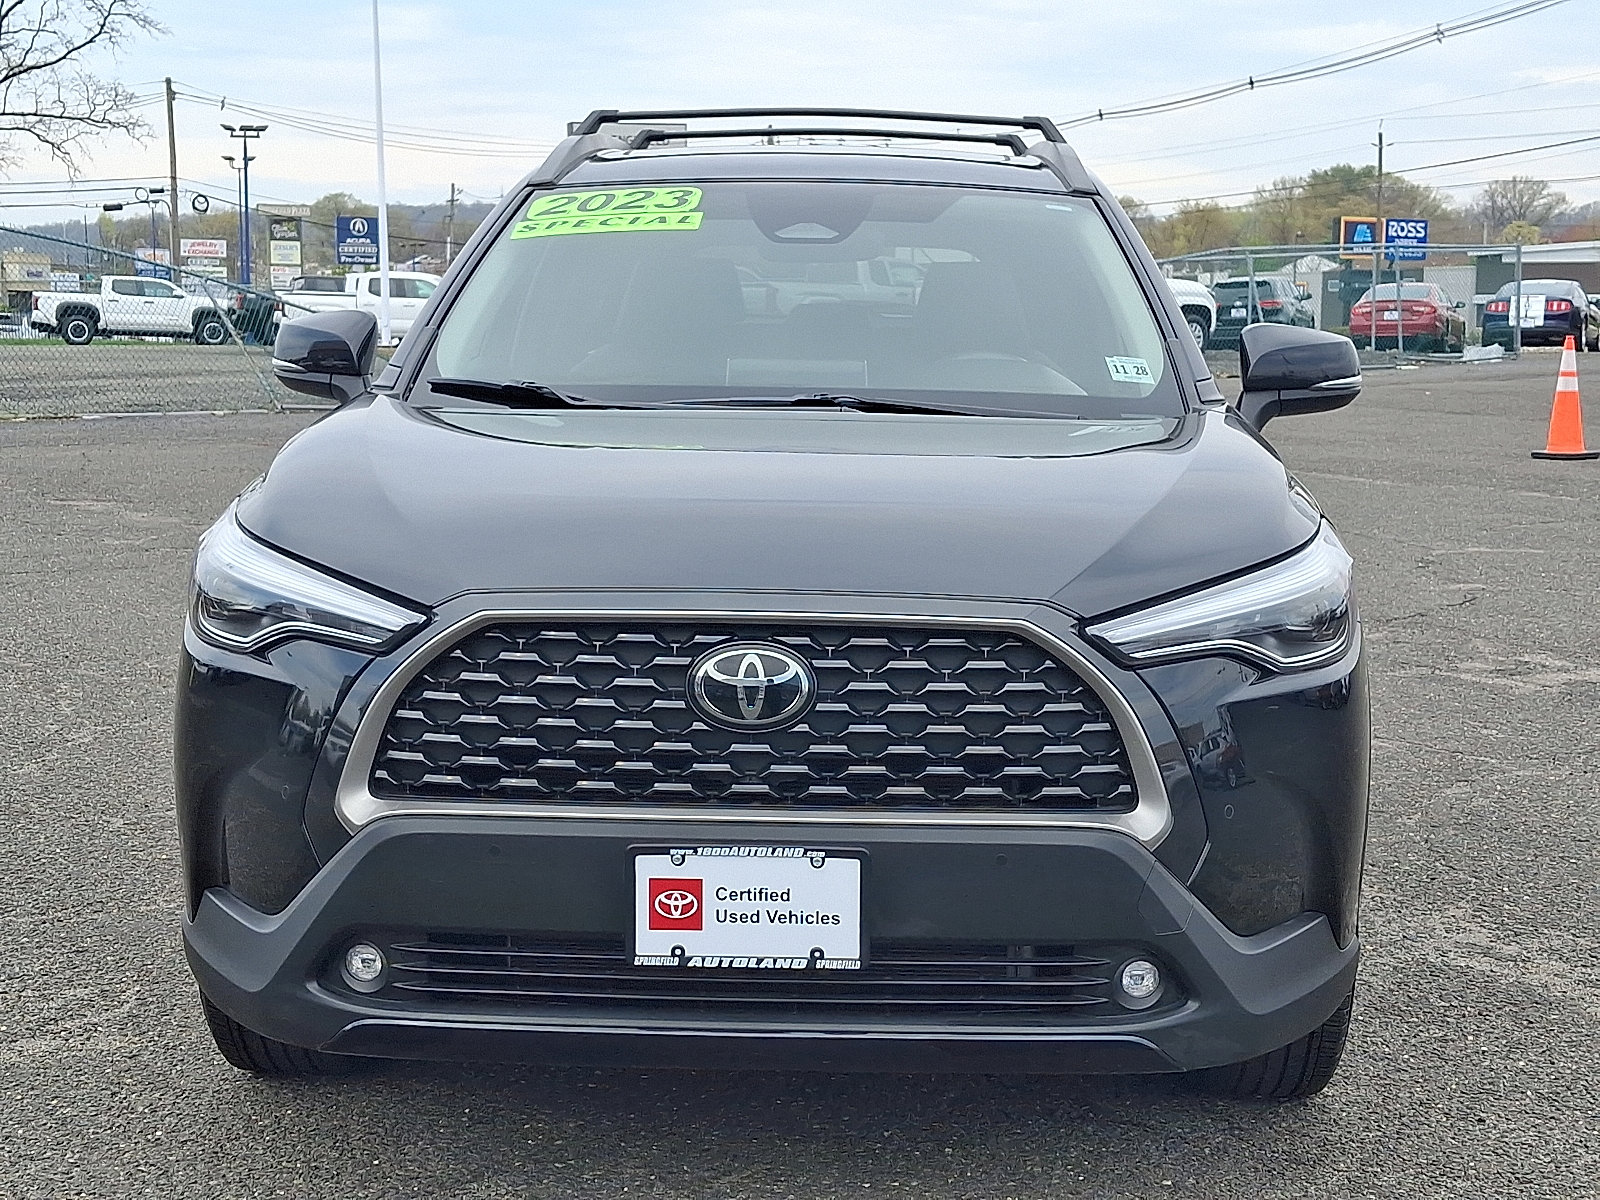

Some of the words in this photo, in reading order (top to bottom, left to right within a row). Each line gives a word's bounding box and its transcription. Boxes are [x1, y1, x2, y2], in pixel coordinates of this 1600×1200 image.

[534, 190, 694, 217] 2023
[517, 215, 692, 233] SPECIAL
[1388, 221, 1426, 237] ROSS
[1113, 364, 1130, 375] 11
[1132, 365, 1149, 376] 28
[669, 847, 826, 858] www.1800AUTOLAND.com
[715, 886, 791, 902] Certified
[715, 909, 760, 924] Used
[765, 910, 841, 926] Vehicles
[633, 956, 680, 966] SPRINGFIELD
[686, 957, 808, 970] AUTOLAND
[815, 959, 861, 970] SPRINGFIELD
